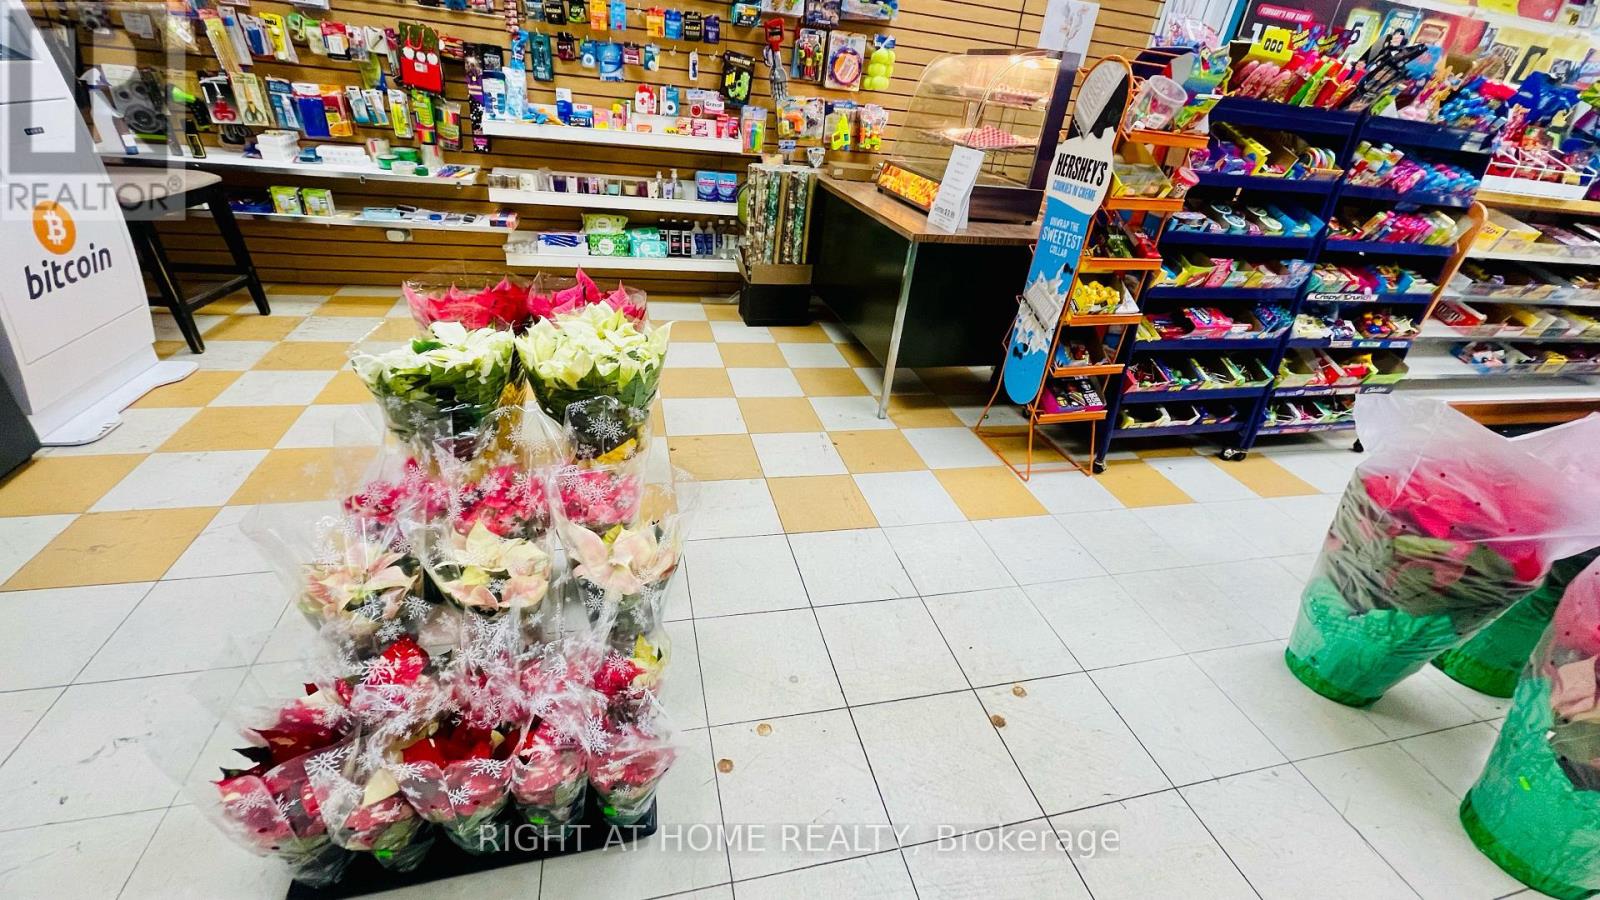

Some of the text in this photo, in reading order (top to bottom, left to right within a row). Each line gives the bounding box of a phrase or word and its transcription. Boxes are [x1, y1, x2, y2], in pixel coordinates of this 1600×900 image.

[1054, 152, 1108, 187] HERSHEY'S
[1041, 226, 1083, 251] SWEETEST
[24, 242, 112, 300] bitcoin
